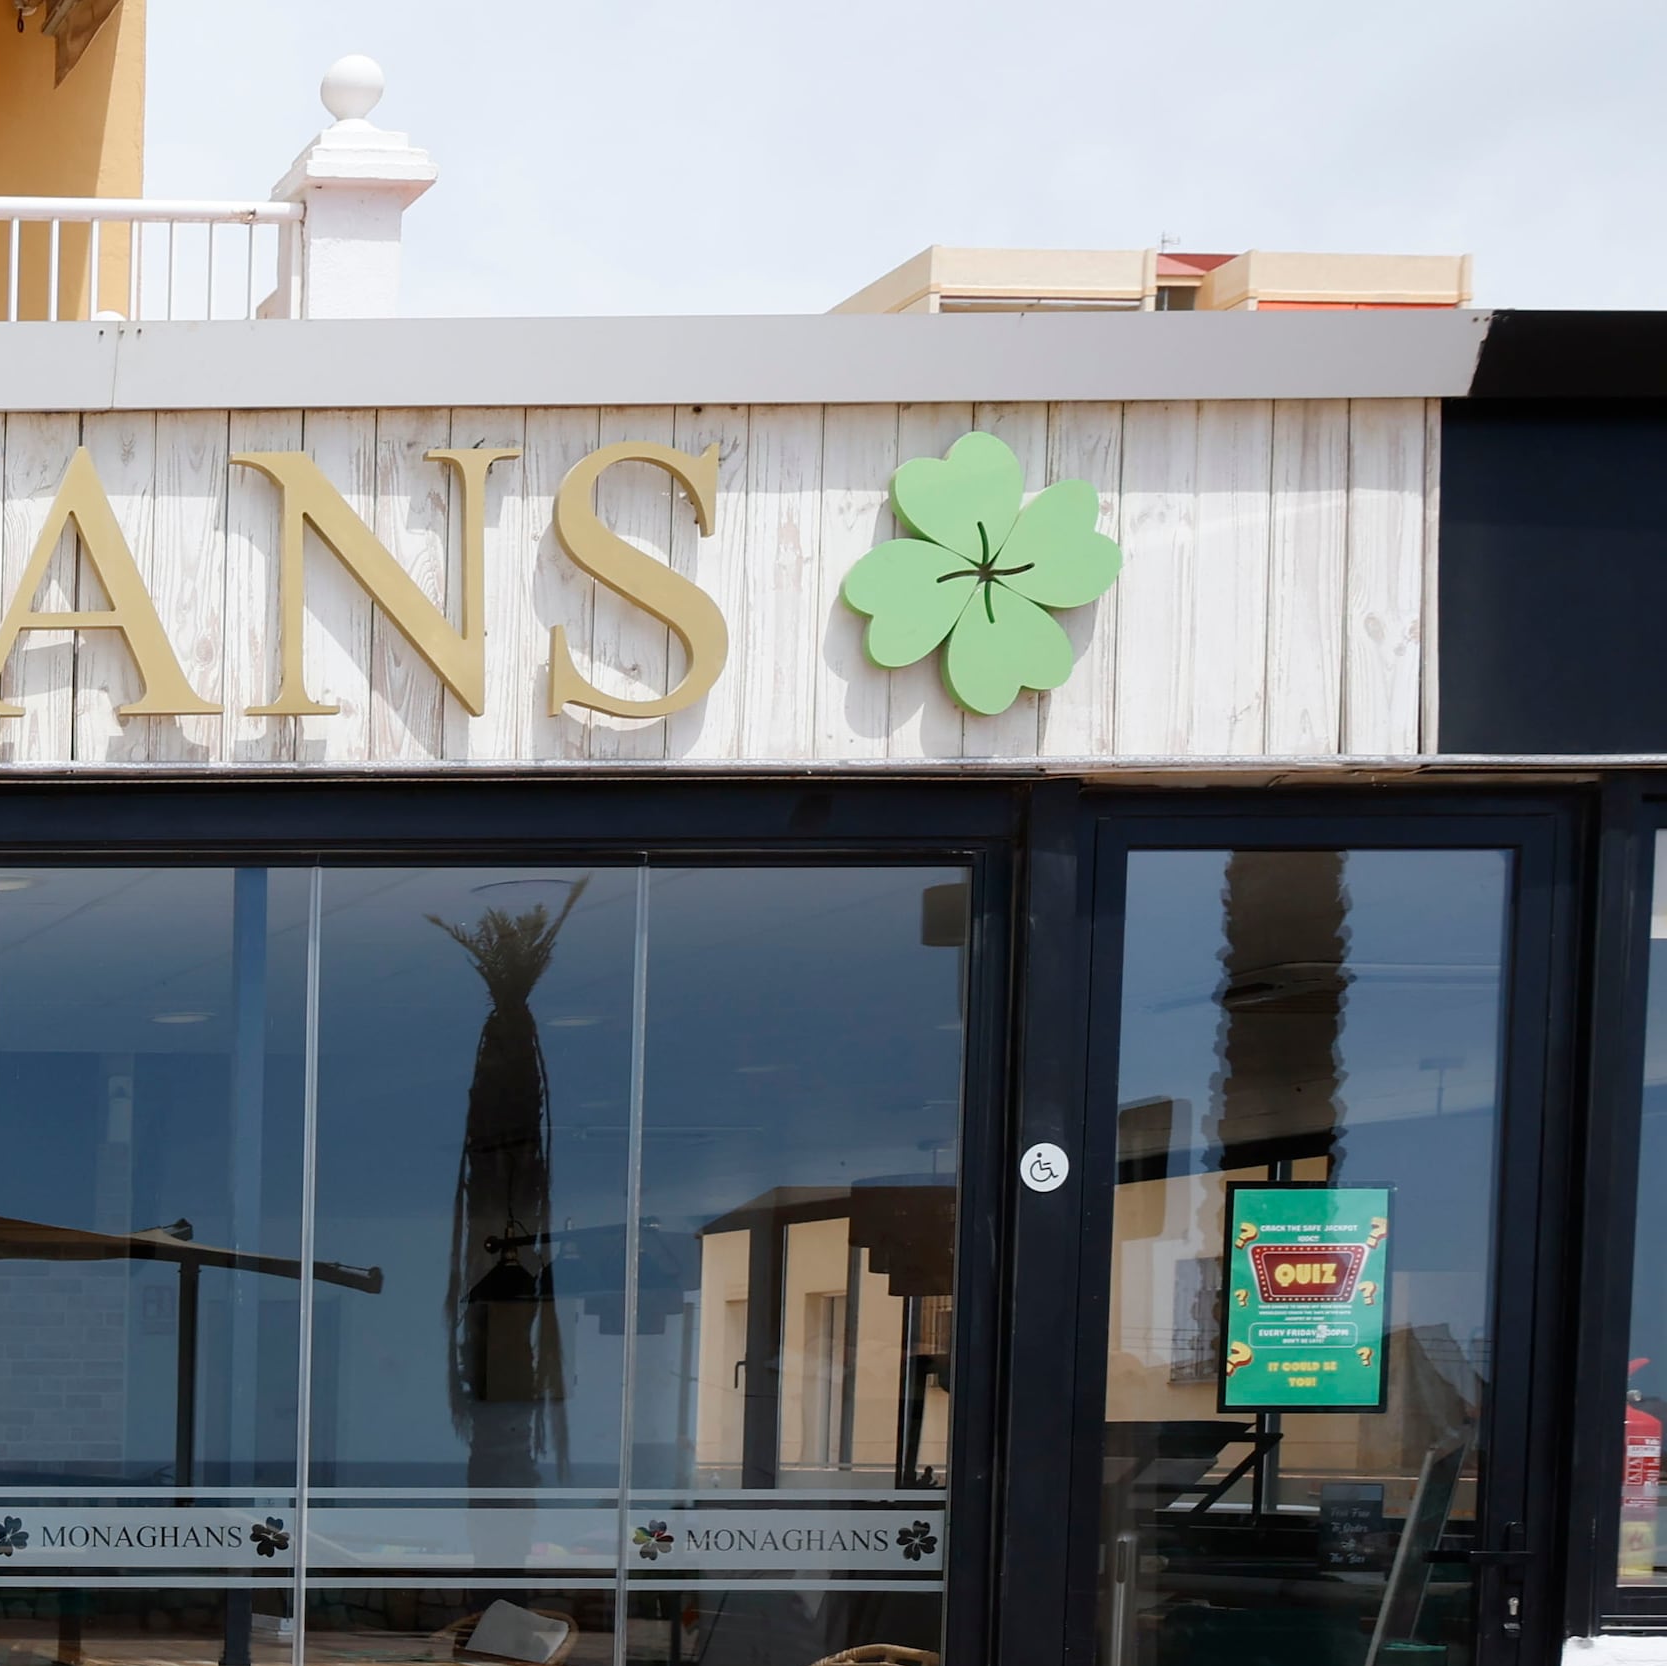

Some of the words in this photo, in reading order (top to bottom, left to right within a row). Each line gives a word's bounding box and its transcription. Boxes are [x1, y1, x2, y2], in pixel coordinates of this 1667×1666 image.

[1287, 1224, 1301, 1232] THE
[1303, 1224, 1321, 1232] SAFE
[1324, 1224, 1358, 1232] JACKPOT
[1274, 1263, 1337, 1287] QUIZ
[1258, 1329, 1285, 1337] EVERY
[1287, 1329, 1316, 1337] FRIDAY
[1268, 1361, 1280, 1371] IT
[1282, 1361, 1321, 1371] COULD
[42, 1526, 242, 1548] MONAGHANS
[686, 1529, 888, 1551] MONAGHANS
